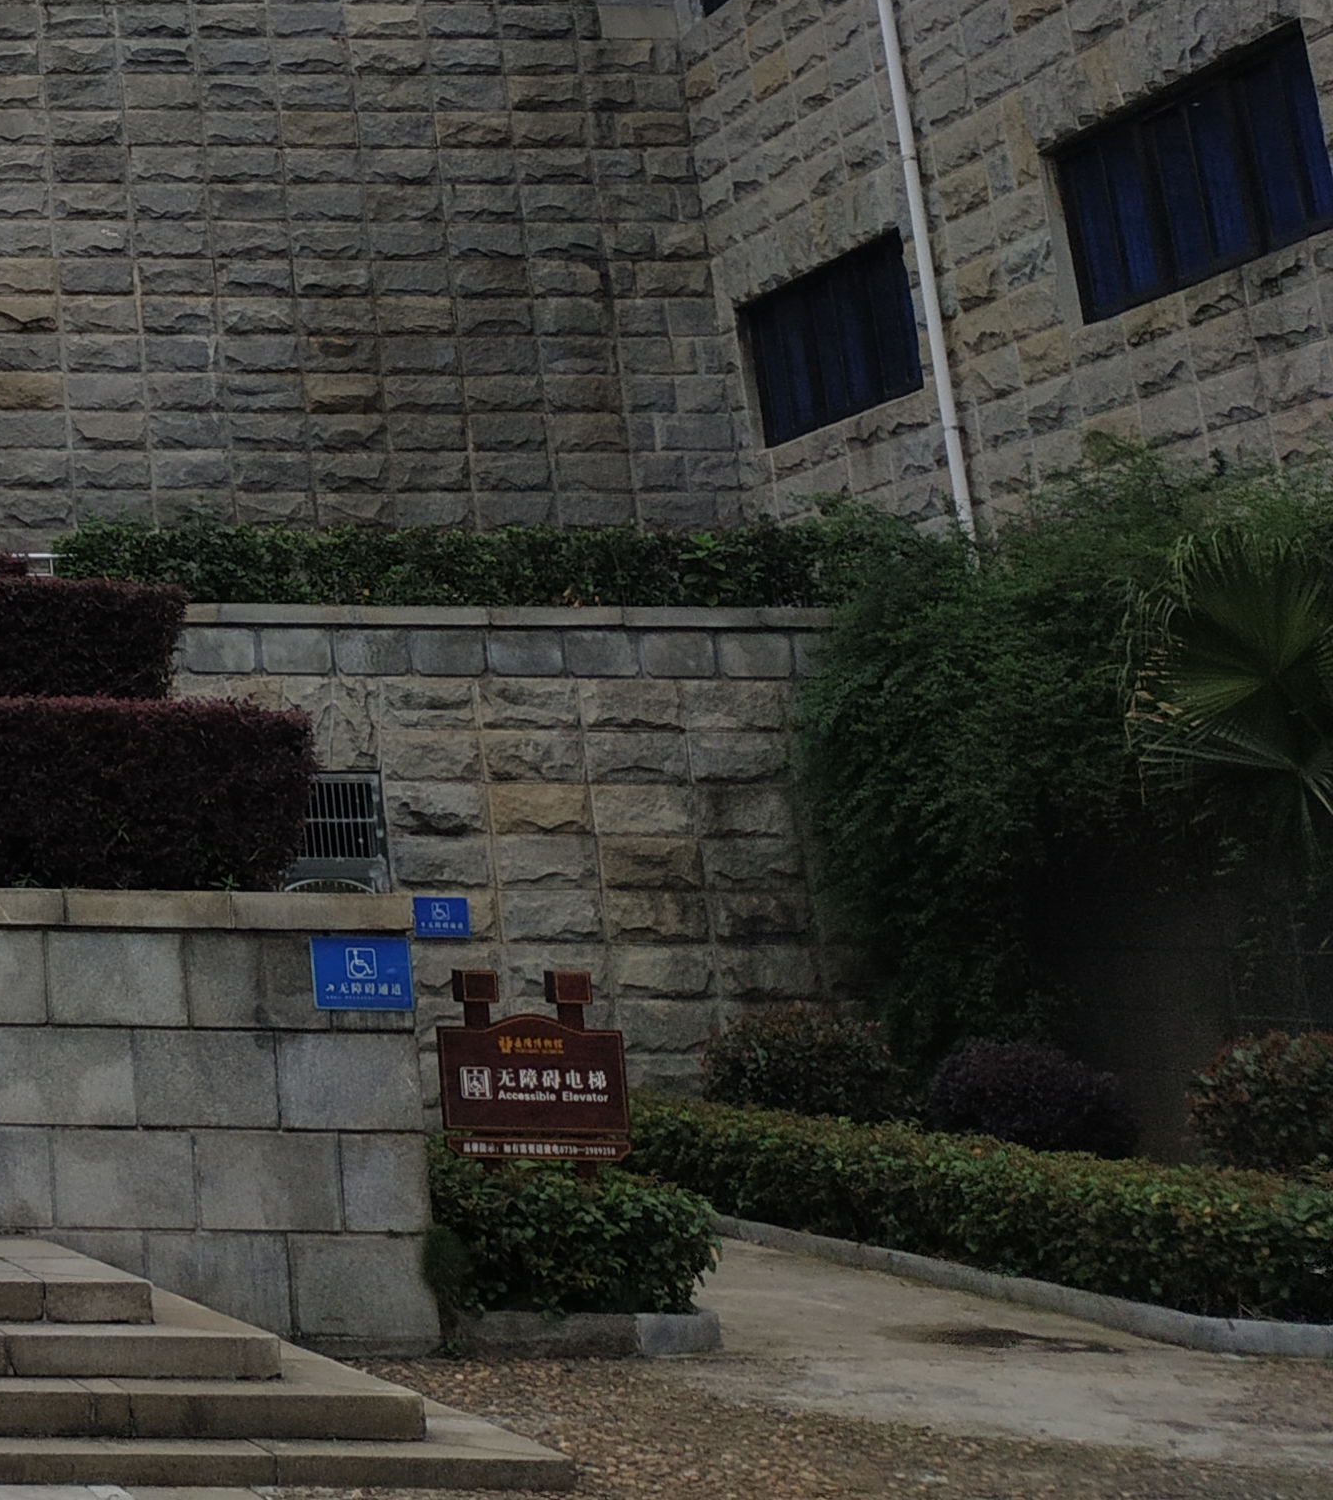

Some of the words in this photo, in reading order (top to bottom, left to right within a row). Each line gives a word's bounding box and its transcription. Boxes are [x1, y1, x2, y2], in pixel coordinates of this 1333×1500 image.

[339, 981, 402, 996] 无障碍通道
[497, 1068, 608, 1090] 无障碍电梯
[497, 1090, 557, 1102] Accessible
[562, 1091, 609, 1103] Elevator
